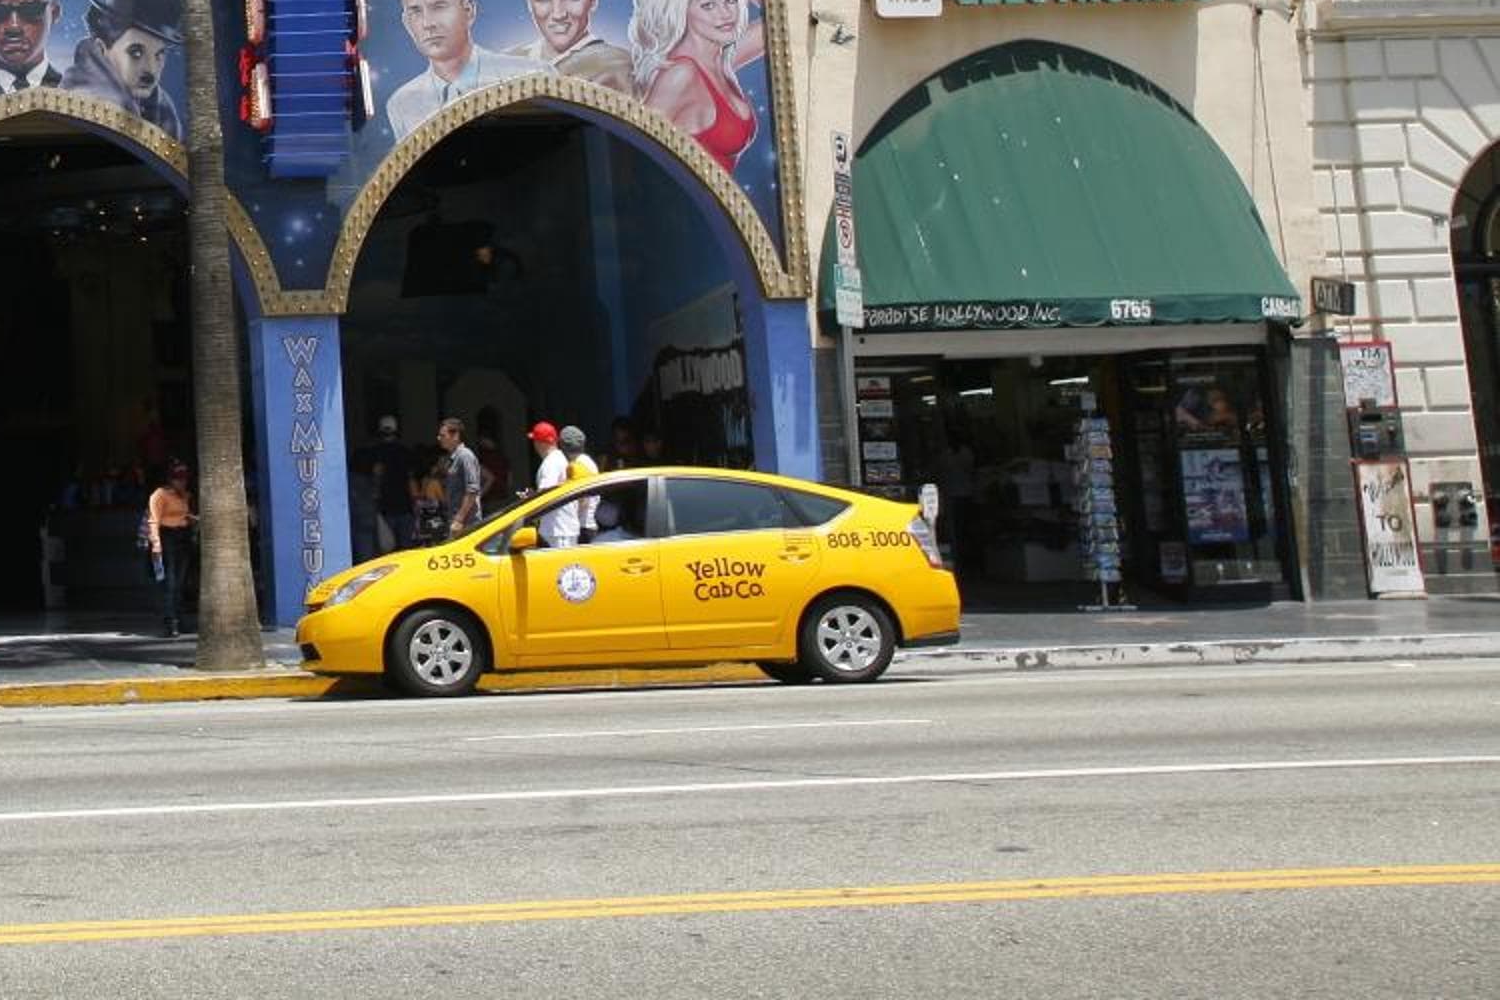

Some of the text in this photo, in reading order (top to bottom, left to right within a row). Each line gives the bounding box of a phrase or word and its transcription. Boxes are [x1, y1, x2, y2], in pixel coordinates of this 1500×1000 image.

[1111, 299, 1151, 319] 6765
[283, 335, 319, 413] WAX
[1376, 515, 1403, 532] TO
[827, 531, 911, 549] 808-1000
[427, 554, 476, 571] 6355
[685, 557, 766, 581] Yellow
[694, 582, 733, 601] Cab
